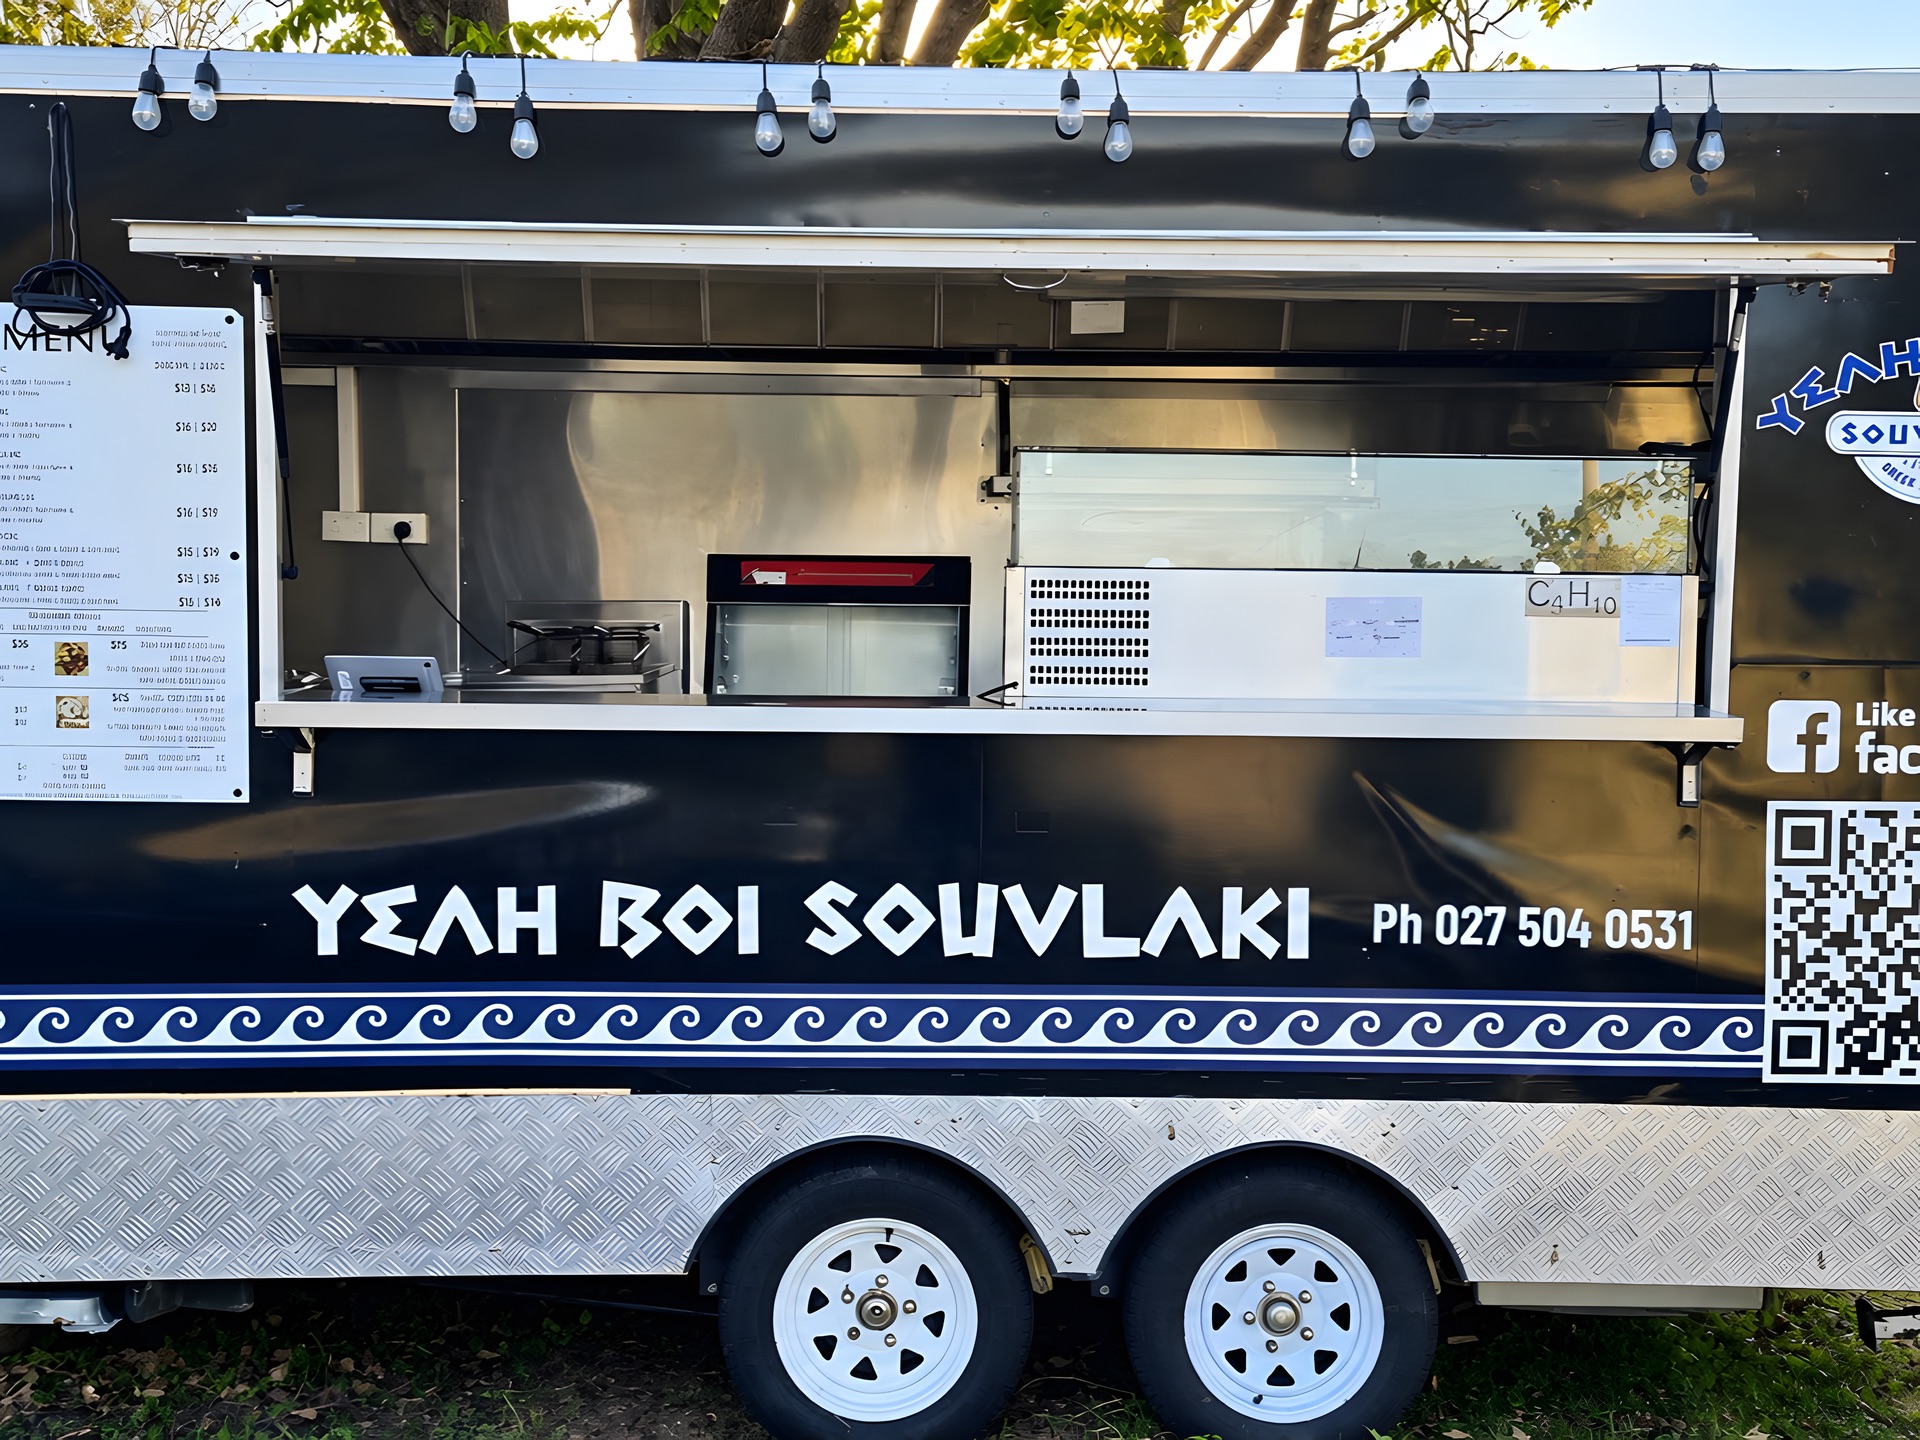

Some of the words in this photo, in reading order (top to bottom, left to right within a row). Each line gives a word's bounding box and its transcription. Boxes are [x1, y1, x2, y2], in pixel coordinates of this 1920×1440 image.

[1856, 702, 1916, 727] Like
[292, 885, 557, 956] YEAH
[600, 881, 759, 958] BOI
[804, 881, 1310, 960] SOUVLAKI
[1373, 903, 1422, 945] Ph
[1435, 904, 1507, 946] 027
[1518, 906, 1592, 948] 504
[1605, 908, 1693, 950] 0531
